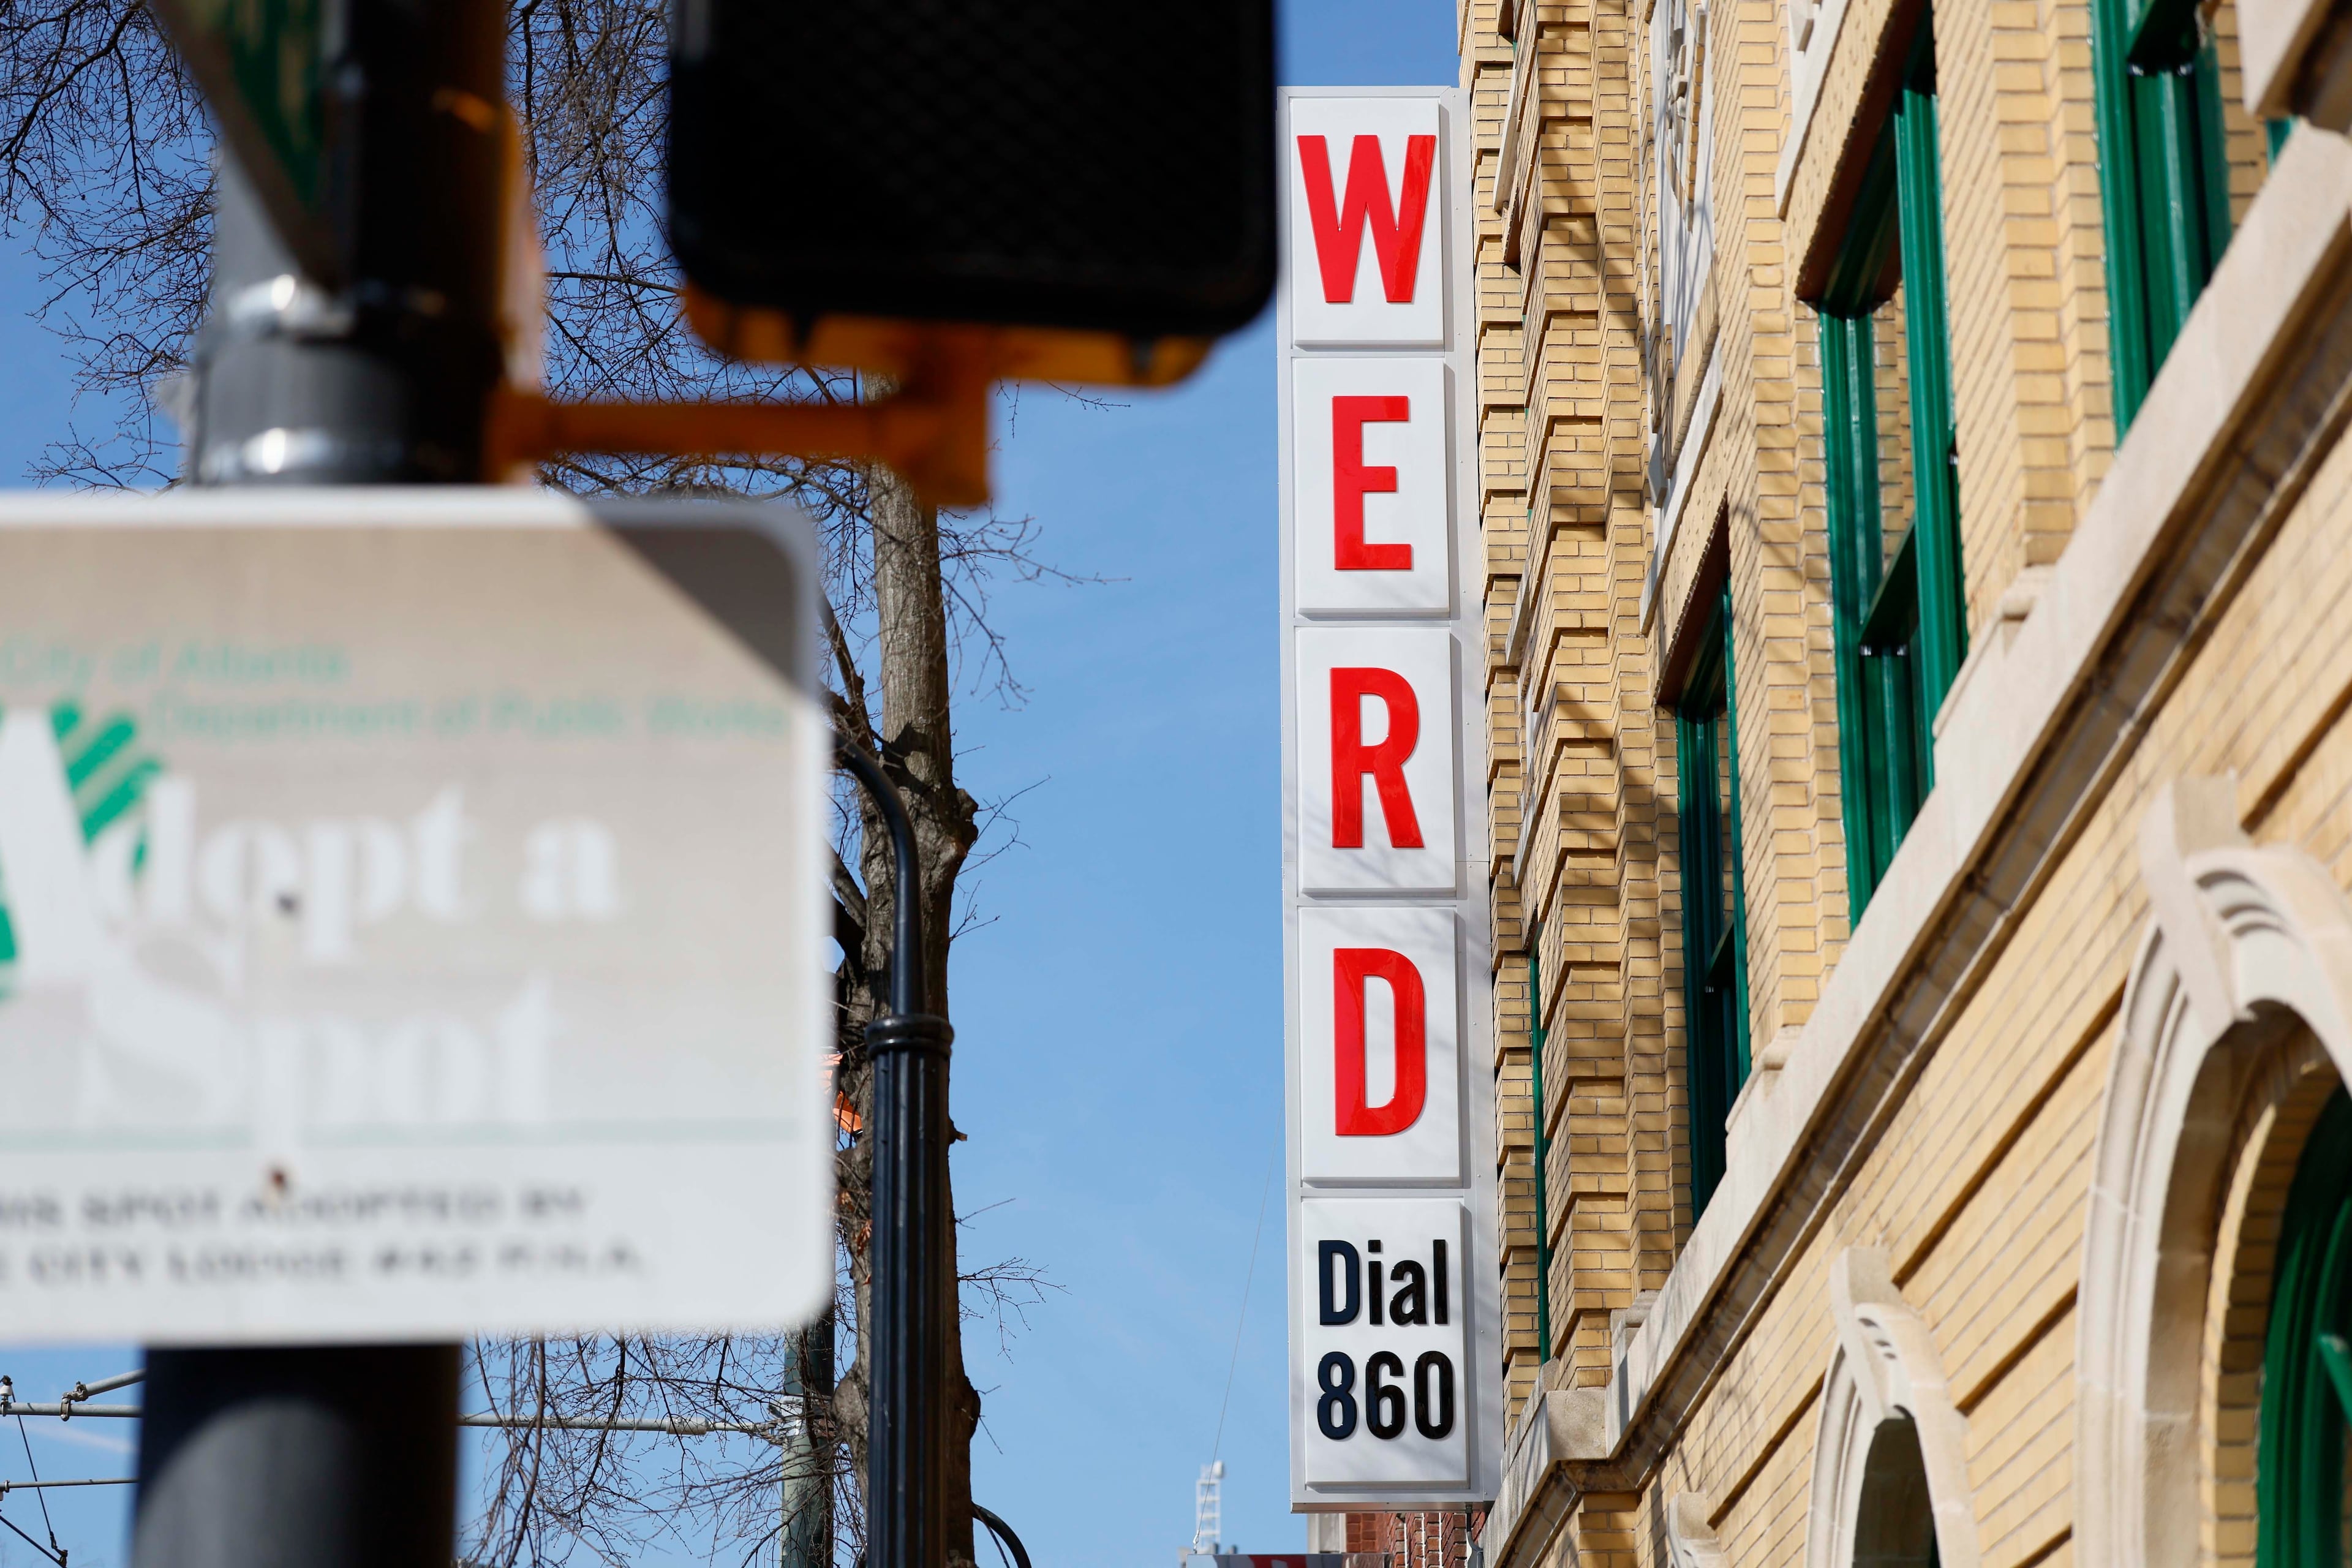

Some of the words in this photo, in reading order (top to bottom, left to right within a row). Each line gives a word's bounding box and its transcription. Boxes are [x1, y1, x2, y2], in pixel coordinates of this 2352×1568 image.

[1297, 135, 1436, 1137] WERD
[521, 816, 625, 922] a
[80, 928, 559, 1158] Spot
[1318, 1238, 1448, 1325] Dial
[1317, 1351, 1455, 1440] 860
